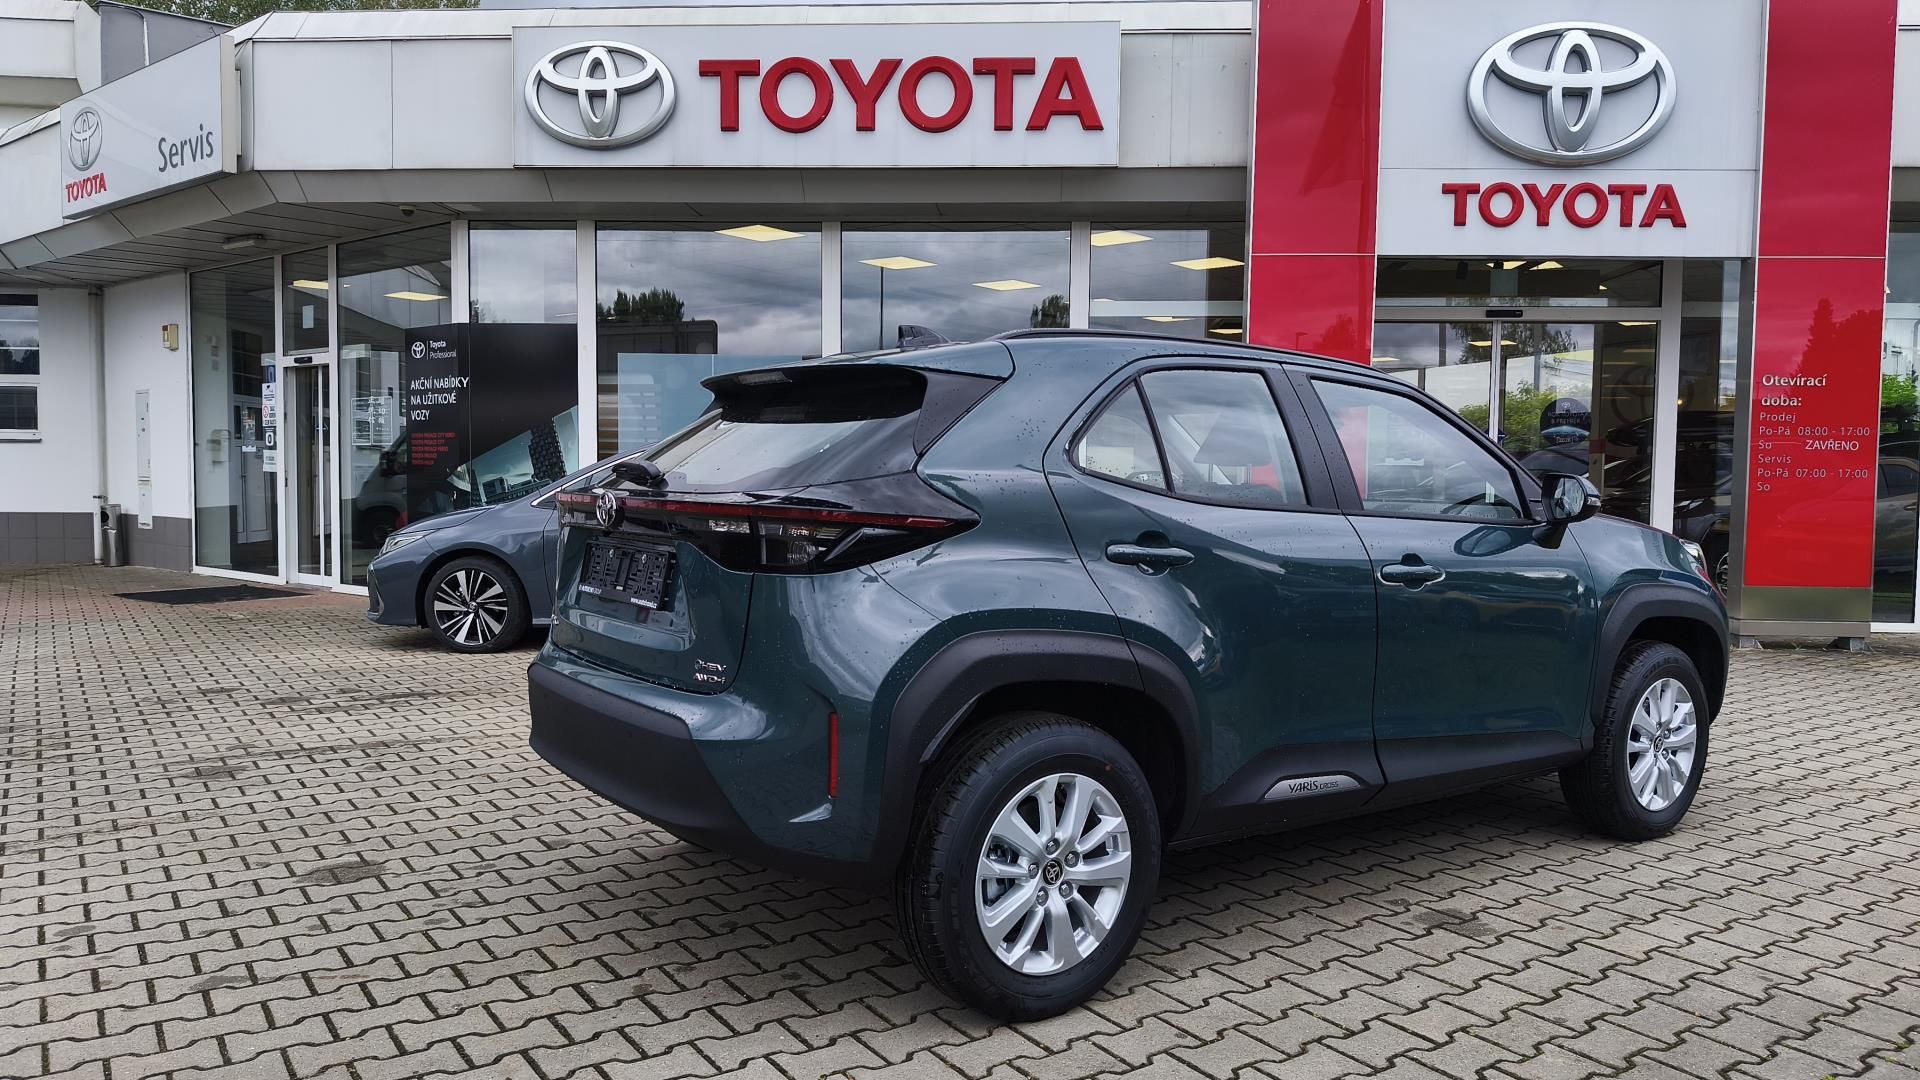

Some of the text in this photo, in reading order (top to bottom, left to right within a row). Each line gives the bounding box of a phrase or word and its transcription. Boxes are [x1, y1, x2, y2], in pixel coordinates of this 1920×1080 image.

[698, 55, 1105, 134] TOYOTA
[158, 123, 214, 173] Servis
[65, 172, 107, 203] TOYOTA
[1441, 181, 1687, 229] TOYOTA
[429, 340, 447, 350] Toyota
[429, 348, 457, 359] Professional
[410, 374, 469, 390] AKČNÍ NABÍDKY
[1762, 373, 1828, 387] Otevírací
[410, 390, 457, 405] NA UŽITKOVÉ
[1761, 394, 1802, 406] doba:
[410, 409, 430, 421] VOZY
[1760, 412, 1796, 423] Prodej
[1759, 426, 1791, 436] Po-Pá
[1797, 426, 1828, 436] 08:00
[1840, 427, 1870, 436] 17:00
[1758, 439, 1859, 451] So ZAVŘENO
[1758, 454, 1792, 464] Servis
[1757, 468, 1789, 478] Po-Pá
[1795, 468, 1826, 478] 07:00
[1838, 469, 1868, 478] 17:00
[1757, 482, 1770, 491] So
[1320, 781, 1339, 790] CROSS
